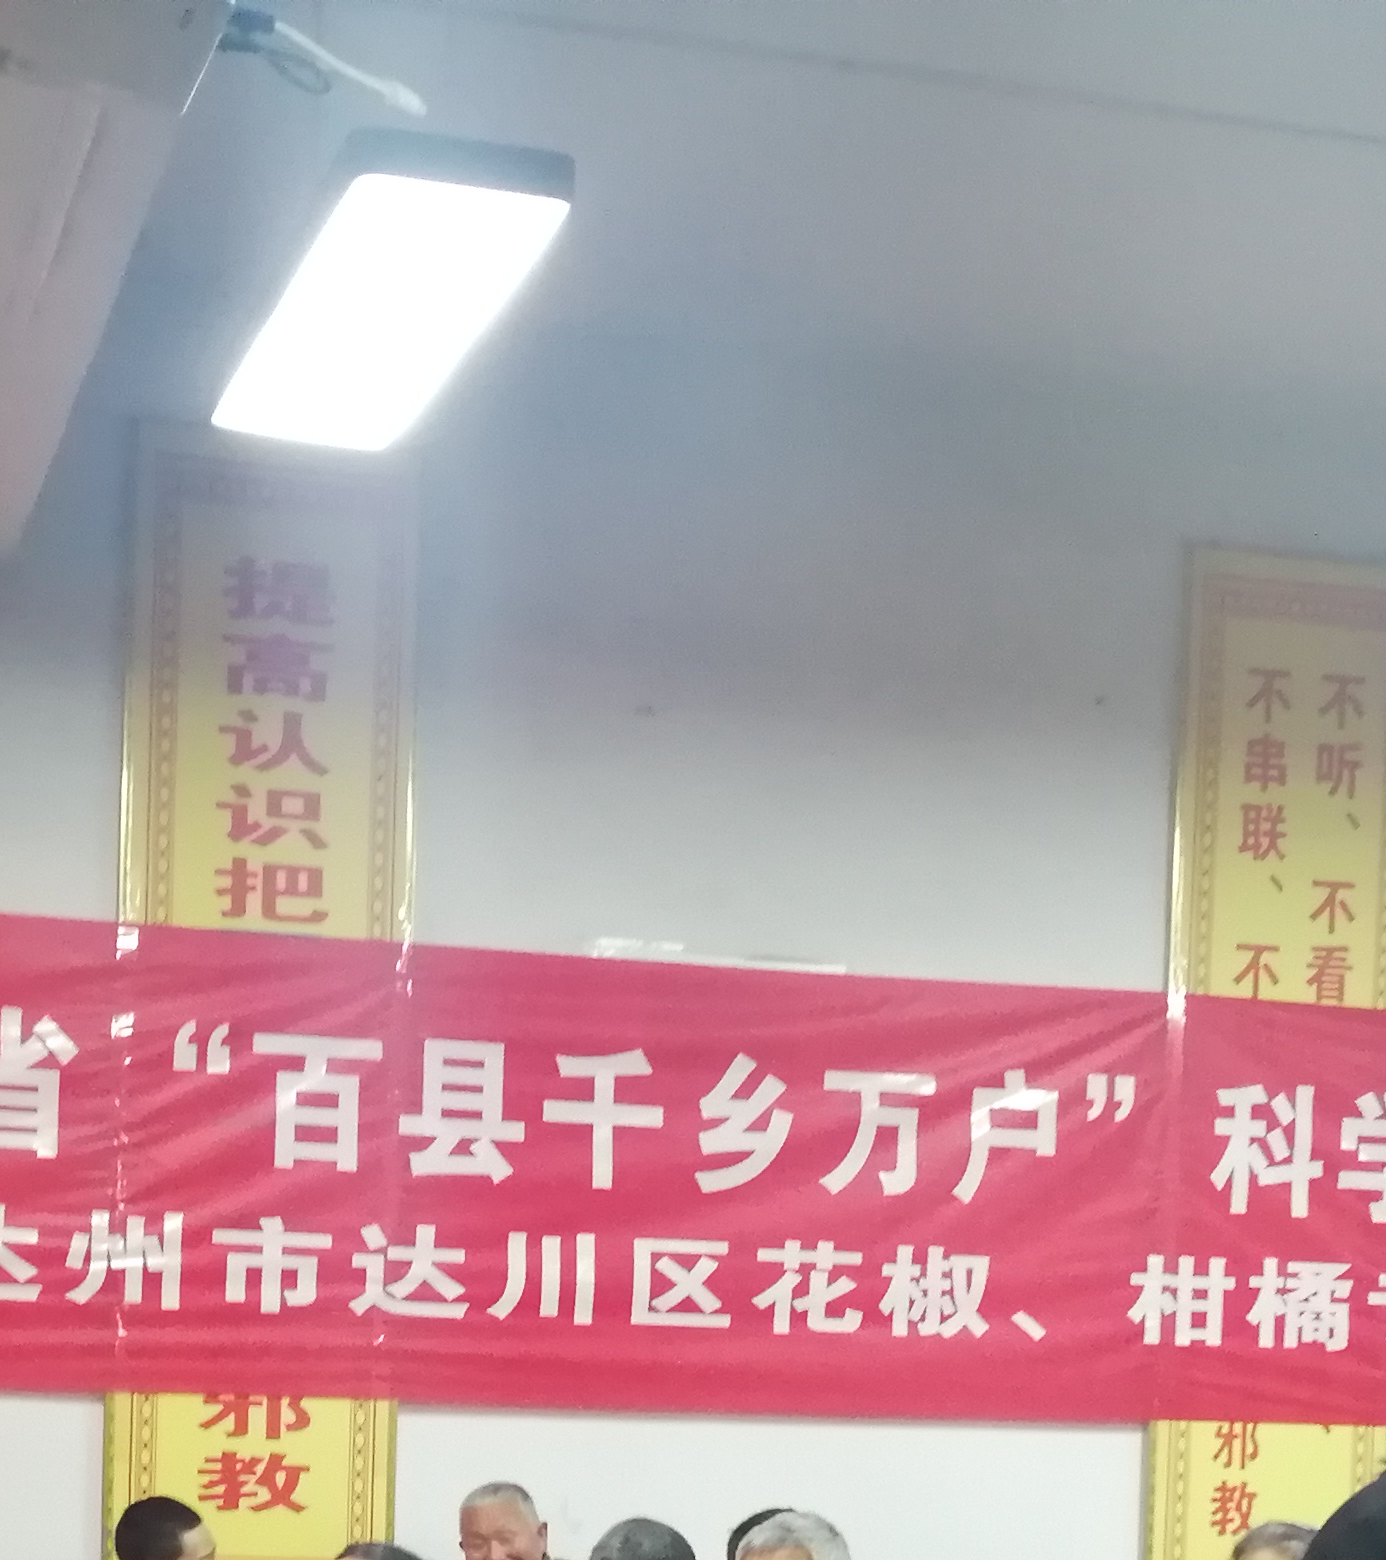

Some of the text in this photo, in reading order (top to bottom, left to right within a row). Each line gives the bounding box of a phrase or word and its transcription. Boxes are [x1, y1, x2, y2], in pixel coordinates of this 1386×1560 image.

[214, 554, 335, 924] 提高认识把
[1233, 667, 1293, 1000] 不串联、不
[1306, 673, 1366, 1003] 不听、不看
[197, 1394, 311, 1513] 邪教
[1211, 1421, 1259, 1536] 邪教
